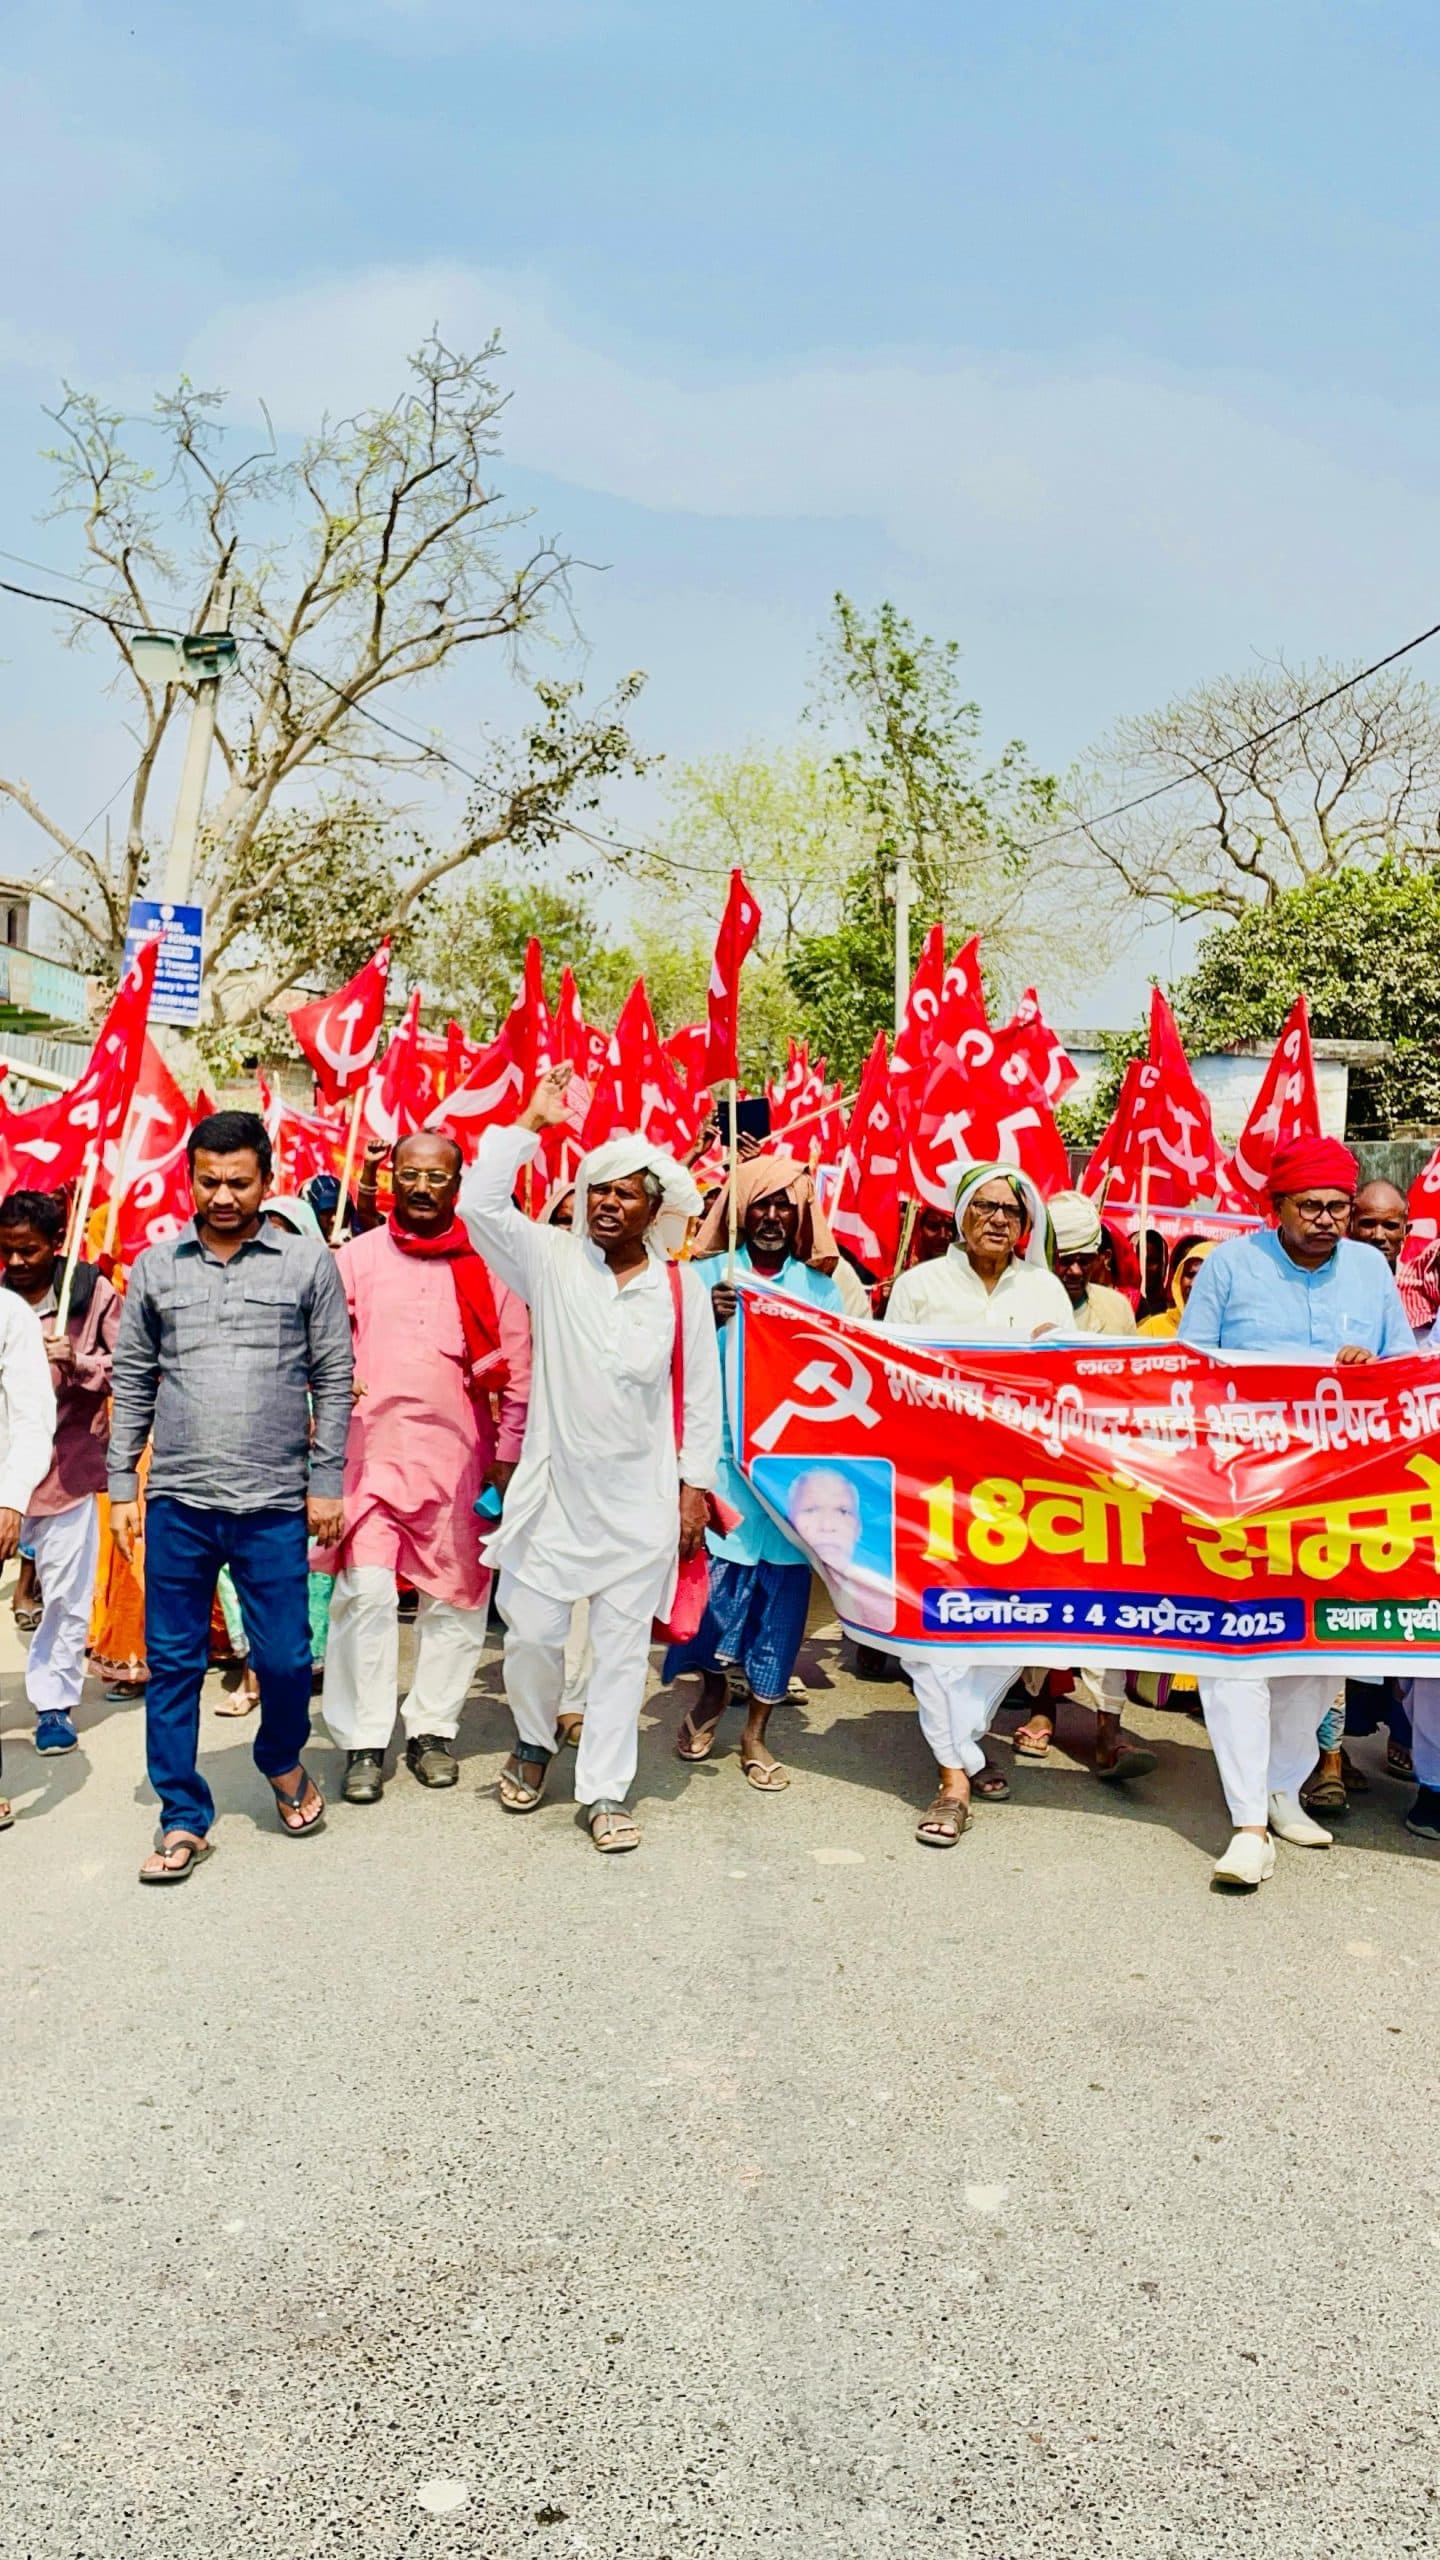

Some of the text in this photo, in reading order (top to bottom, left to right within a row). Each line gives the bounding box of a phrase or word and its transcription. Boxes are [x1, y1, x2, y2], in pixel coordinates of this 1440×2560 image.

[1075, 1358, 1126, 1376] लाल
[883, 1360, 986, 1422] भारतीय
[1292, 1378, 1392, 1451] परिषद
[937, 1592, 1052, 1625] दिनांक
[1084, 1603, 1107, 1627] 4
[1115, 1597, 1215, 1636] अप्रैल
[1219, 1611, 1287, 1638] 2025
[1325, 1607, 1379, 1632] स्थान
